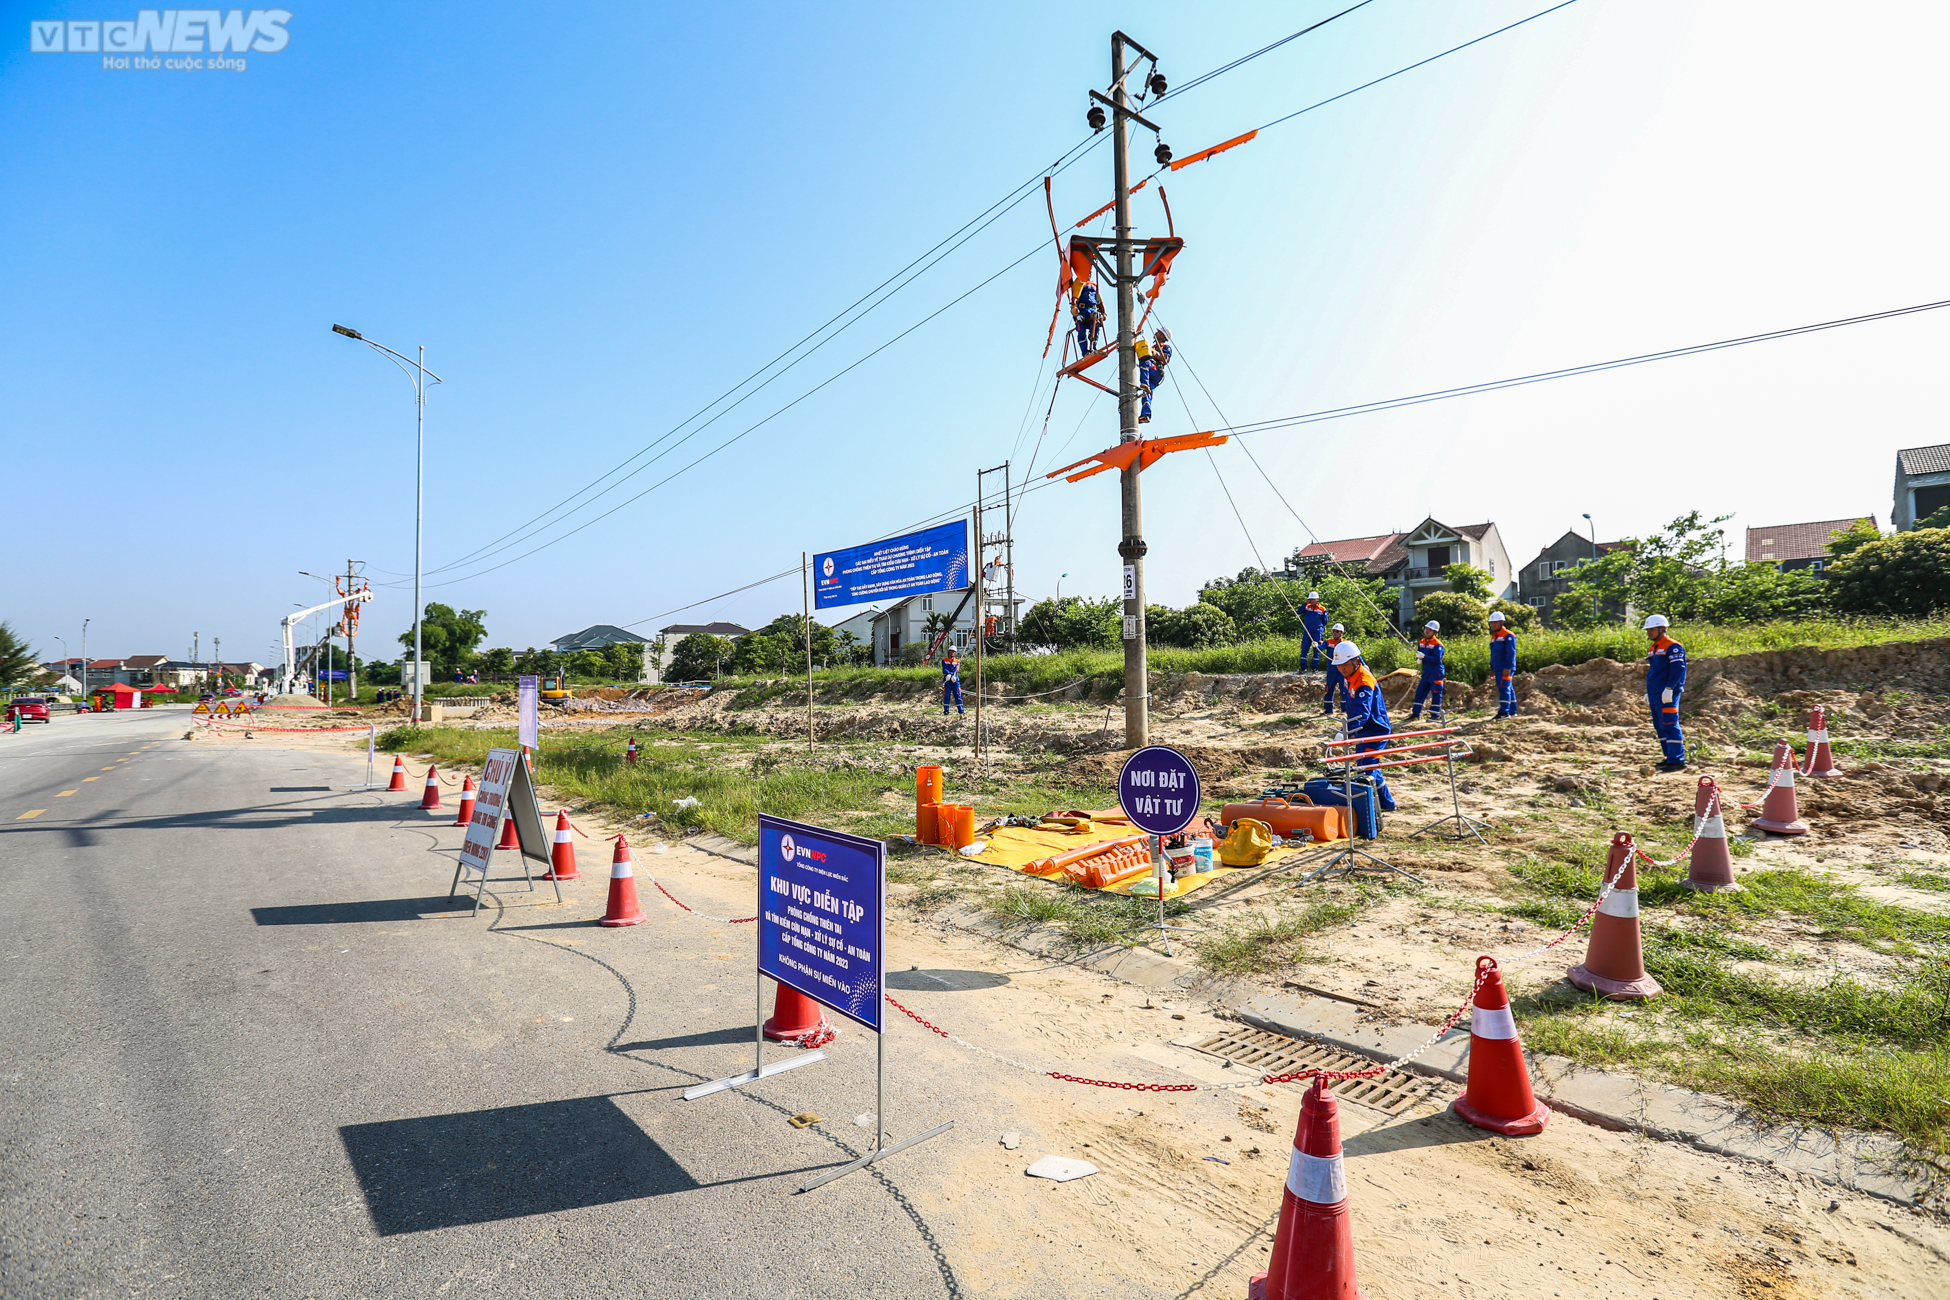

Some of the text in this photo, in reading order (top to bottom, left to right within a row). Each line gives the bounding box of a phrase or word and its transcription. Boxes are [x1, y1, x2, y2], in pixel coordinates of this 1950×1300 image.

[484, 755, 512, 785] CHÚ Ý
[1131, 768, 1186, 792] NƠI ĐẶT
[1135, 794, 1184, 818] VẬT TƯ
[796, 846, 827, 863] EVNNPC
[771, 876, 864, 924] KHU VỰC DIỄN TẬP
[788, 906, 802, 919] PHÒNG
[803, 911, 819, 926] CHỐNG
[820, 918, 833, 931] THIÊN
[765, 910, 771, 921] VÀ
[780, 916, 790, 929] KIẾM
[801, 926, 810, 938] NẠN
[814, 930, 822, 942] XỬ
[822, 934, 828, 944] LÝ
[828, 937, 836, 950] SỰ
[836, 939, 843, 951] CỐ
[848, 945, 855, 956] AN
[856, 948, 870, 962] TOÀN
[782, 931, 848, 969] CẤP TỔNG CÔNG TY NĂM 2023
[779, 954, 797, 969] KHÔNG
[798, 963, 812, 976] PHẬN
[814, 970, 822, 982] SỰ
[837, 981, 851, 996] VÀO
